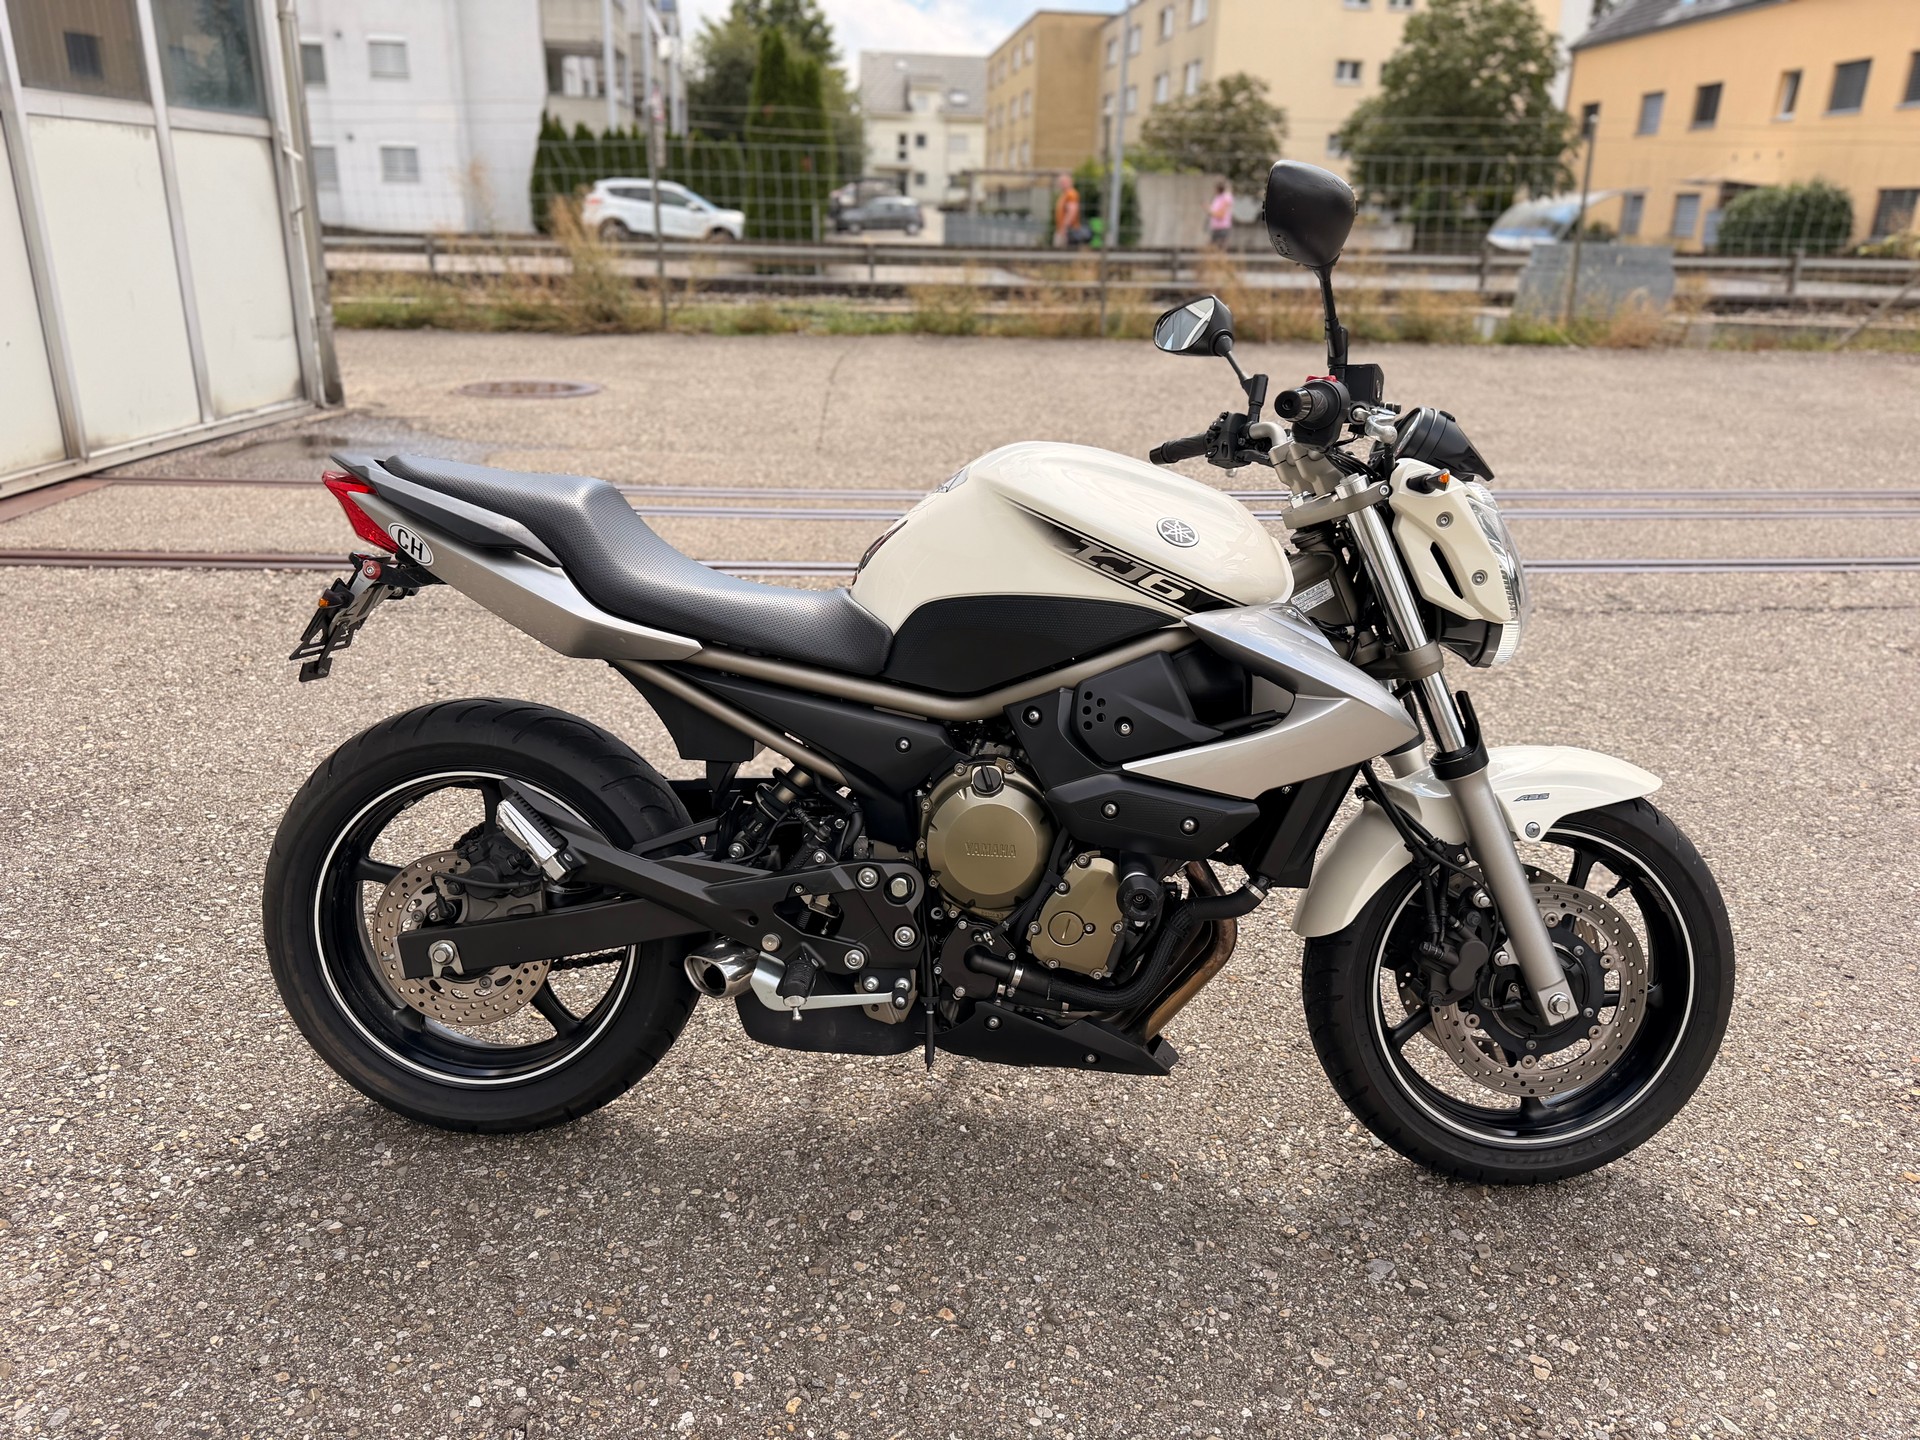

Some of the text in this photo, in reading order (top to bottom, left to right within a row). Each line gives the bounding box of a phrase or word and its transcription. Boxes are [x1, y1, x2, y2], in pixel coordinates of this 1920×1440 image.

[397, 528, 423, 560] CH
[1060, 539, 1193, 600] XJ6
[1513, 792, 1550, 802] ABS
[964, 842, 1017, 858] YAMAHA
